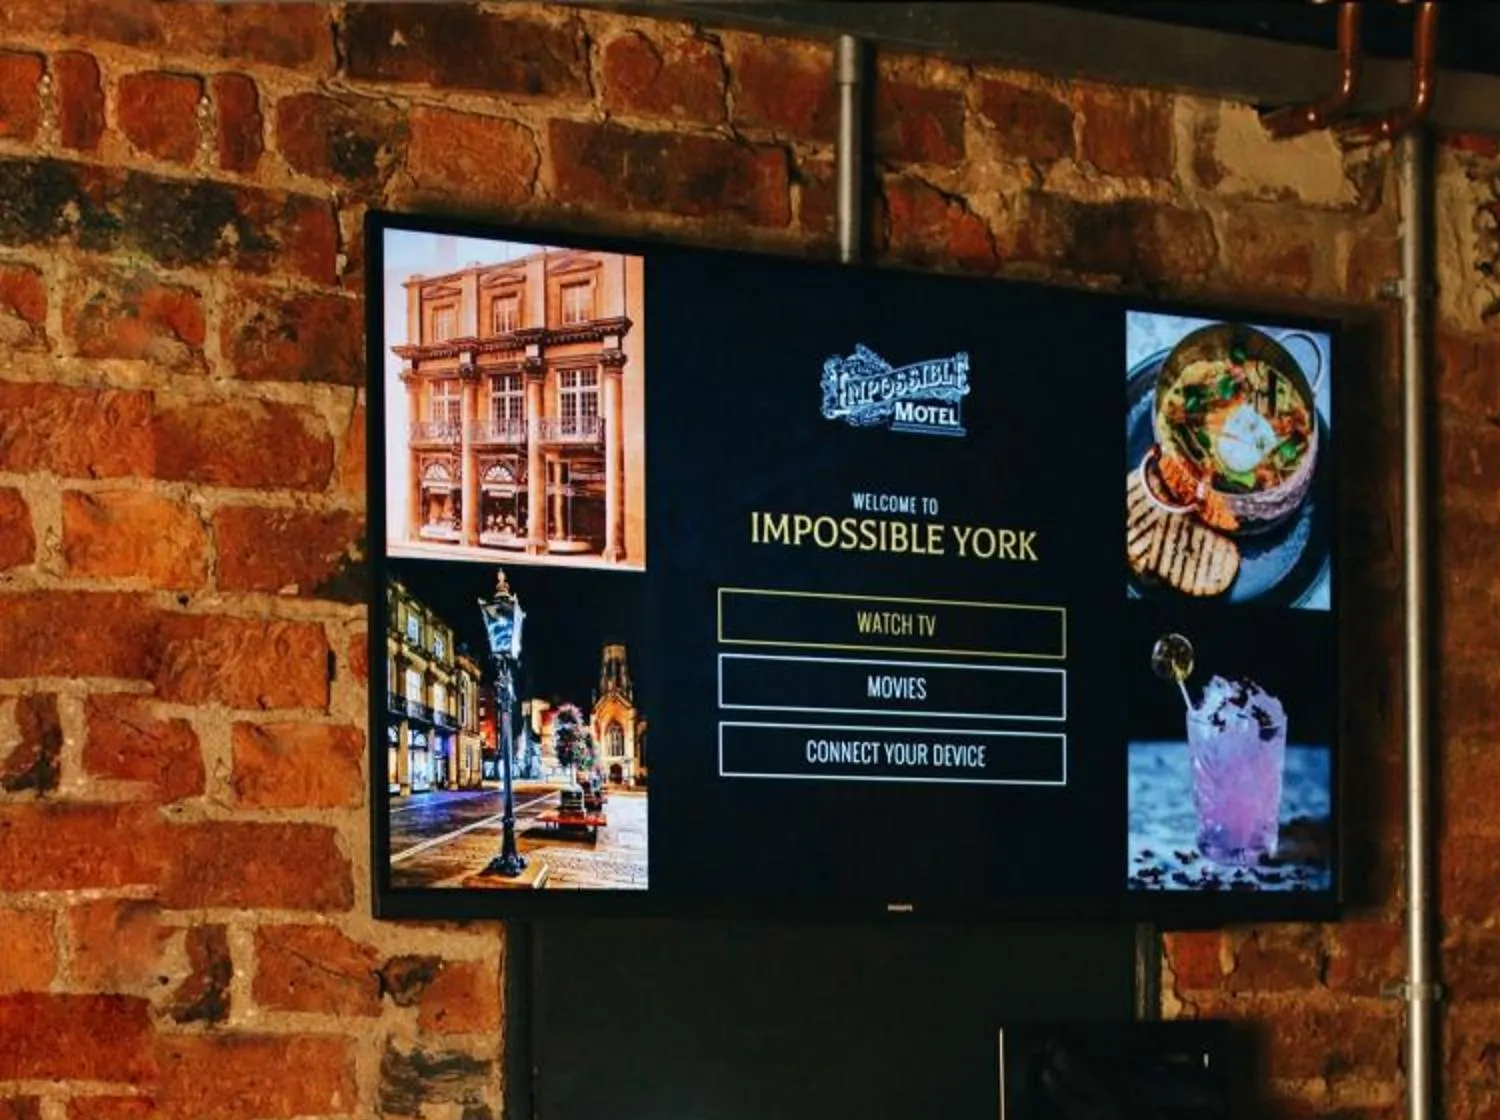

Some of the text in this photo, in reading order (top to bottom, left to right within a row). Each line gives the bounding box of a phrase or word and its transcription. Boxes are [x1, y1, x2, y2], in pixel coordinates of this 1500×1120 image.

[894, 401, 960, 426] MOTEL
[852, 492, 939, 516] WELCOME TO
[750, 511, 1039, 561] IMPOSSIBLE YORK
[856, 611, 936, 637] WATCH TV
[866, 675, 927, 700] MOVIES
[805, 739, 987, 768] CONNECT YOUR DEVICE
